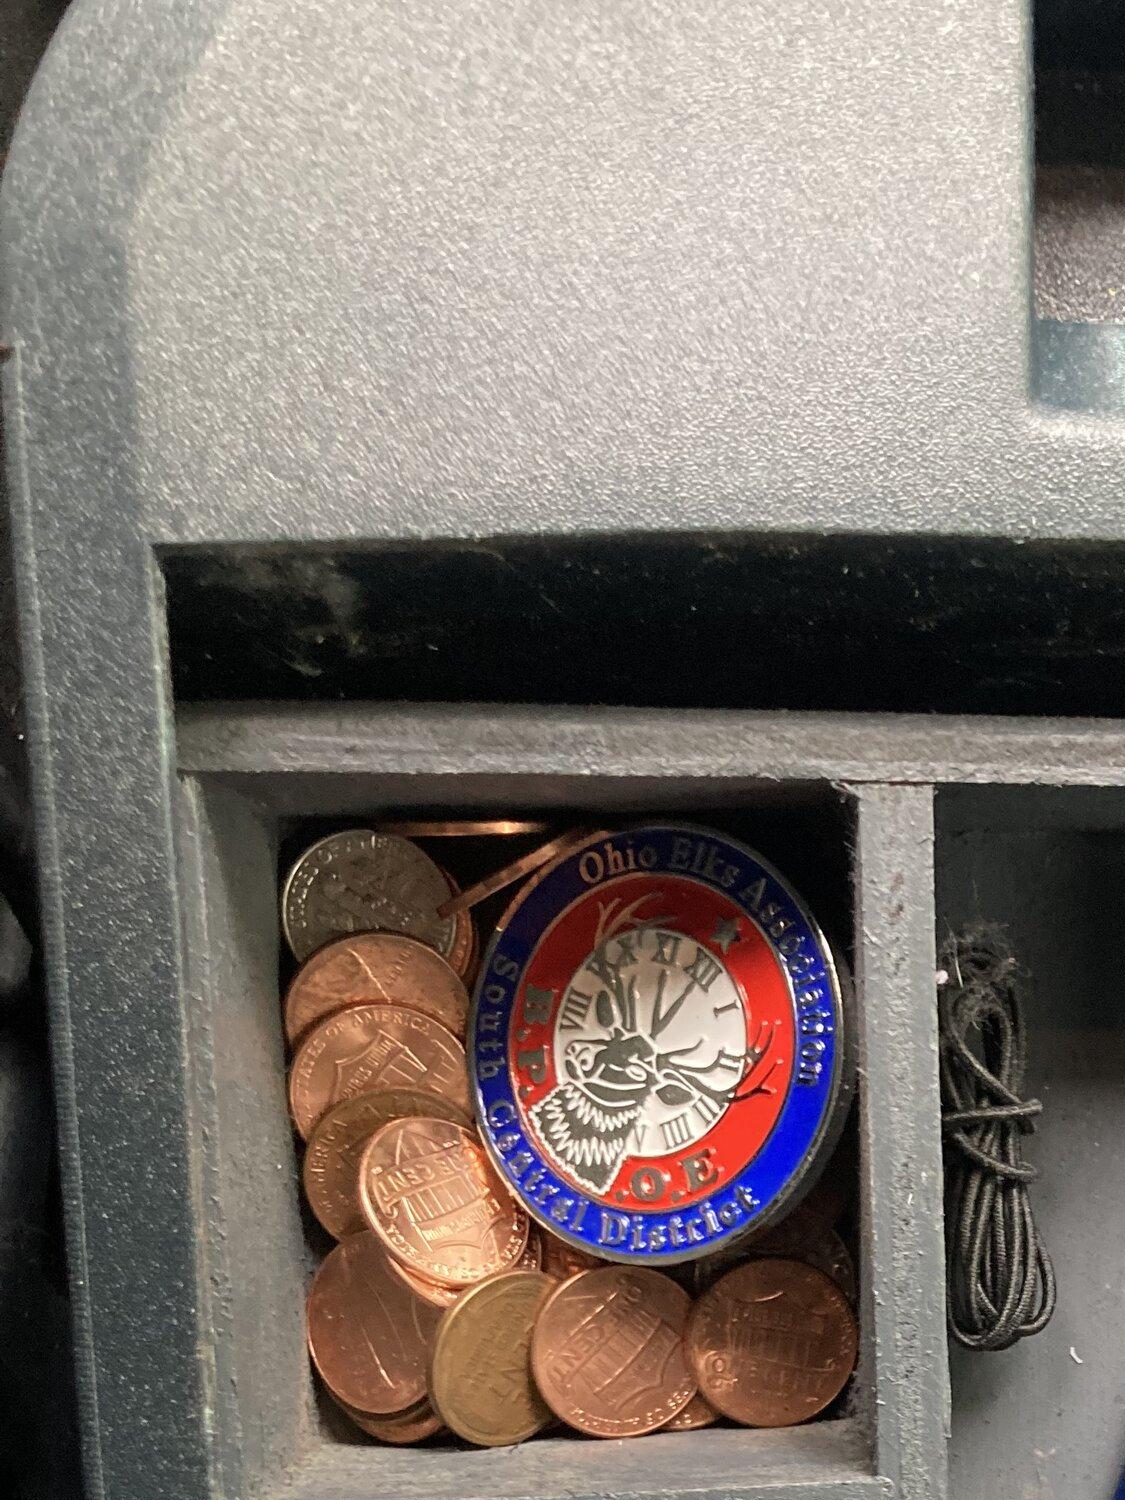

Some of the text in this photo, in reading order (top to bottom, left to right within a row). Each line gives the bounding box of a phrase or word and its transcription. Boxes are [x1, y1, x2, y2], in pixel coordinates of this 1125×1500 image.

[579, 837, 834, 1086] Ohio Elks Association
[378, 1166, 436, 1202] CENT
[479, 954, 760, 1251] South Central District
